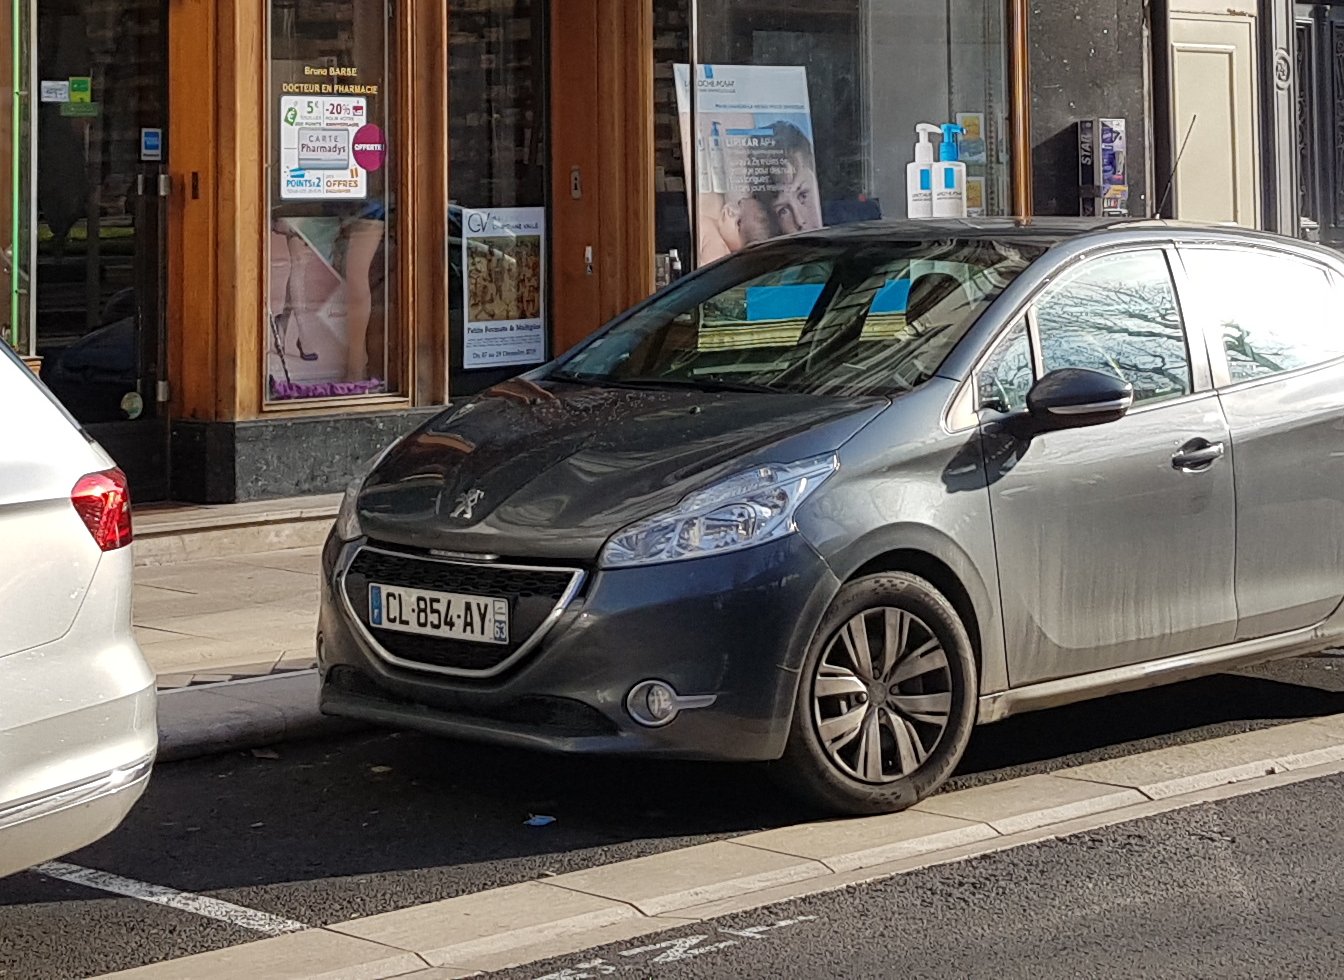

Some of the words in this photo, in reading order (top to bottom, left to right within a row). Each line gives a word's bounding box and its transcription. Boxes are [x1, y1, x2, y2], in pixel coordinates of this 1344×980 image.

[304, 66, 328, 76] Bruno
[282, 83, 320, 93] DOCTEUR
[321, 84, 332, 93] EN
[333, 84, 379, 95] PHARMACIE
[325, 102, 351, 116] -20%
[308, 135, 339, 143] CARTE
[725, 137, 759, 147] LIPIKAR
[301, 144, 346, 156] Pharmadys
[1080, 132, 1093, 166] STAR
[325, 180, 359, 188] OFFRES
[385, 591, 489, 636] CL-854-AY
[494, 622, 507, 639] 63
